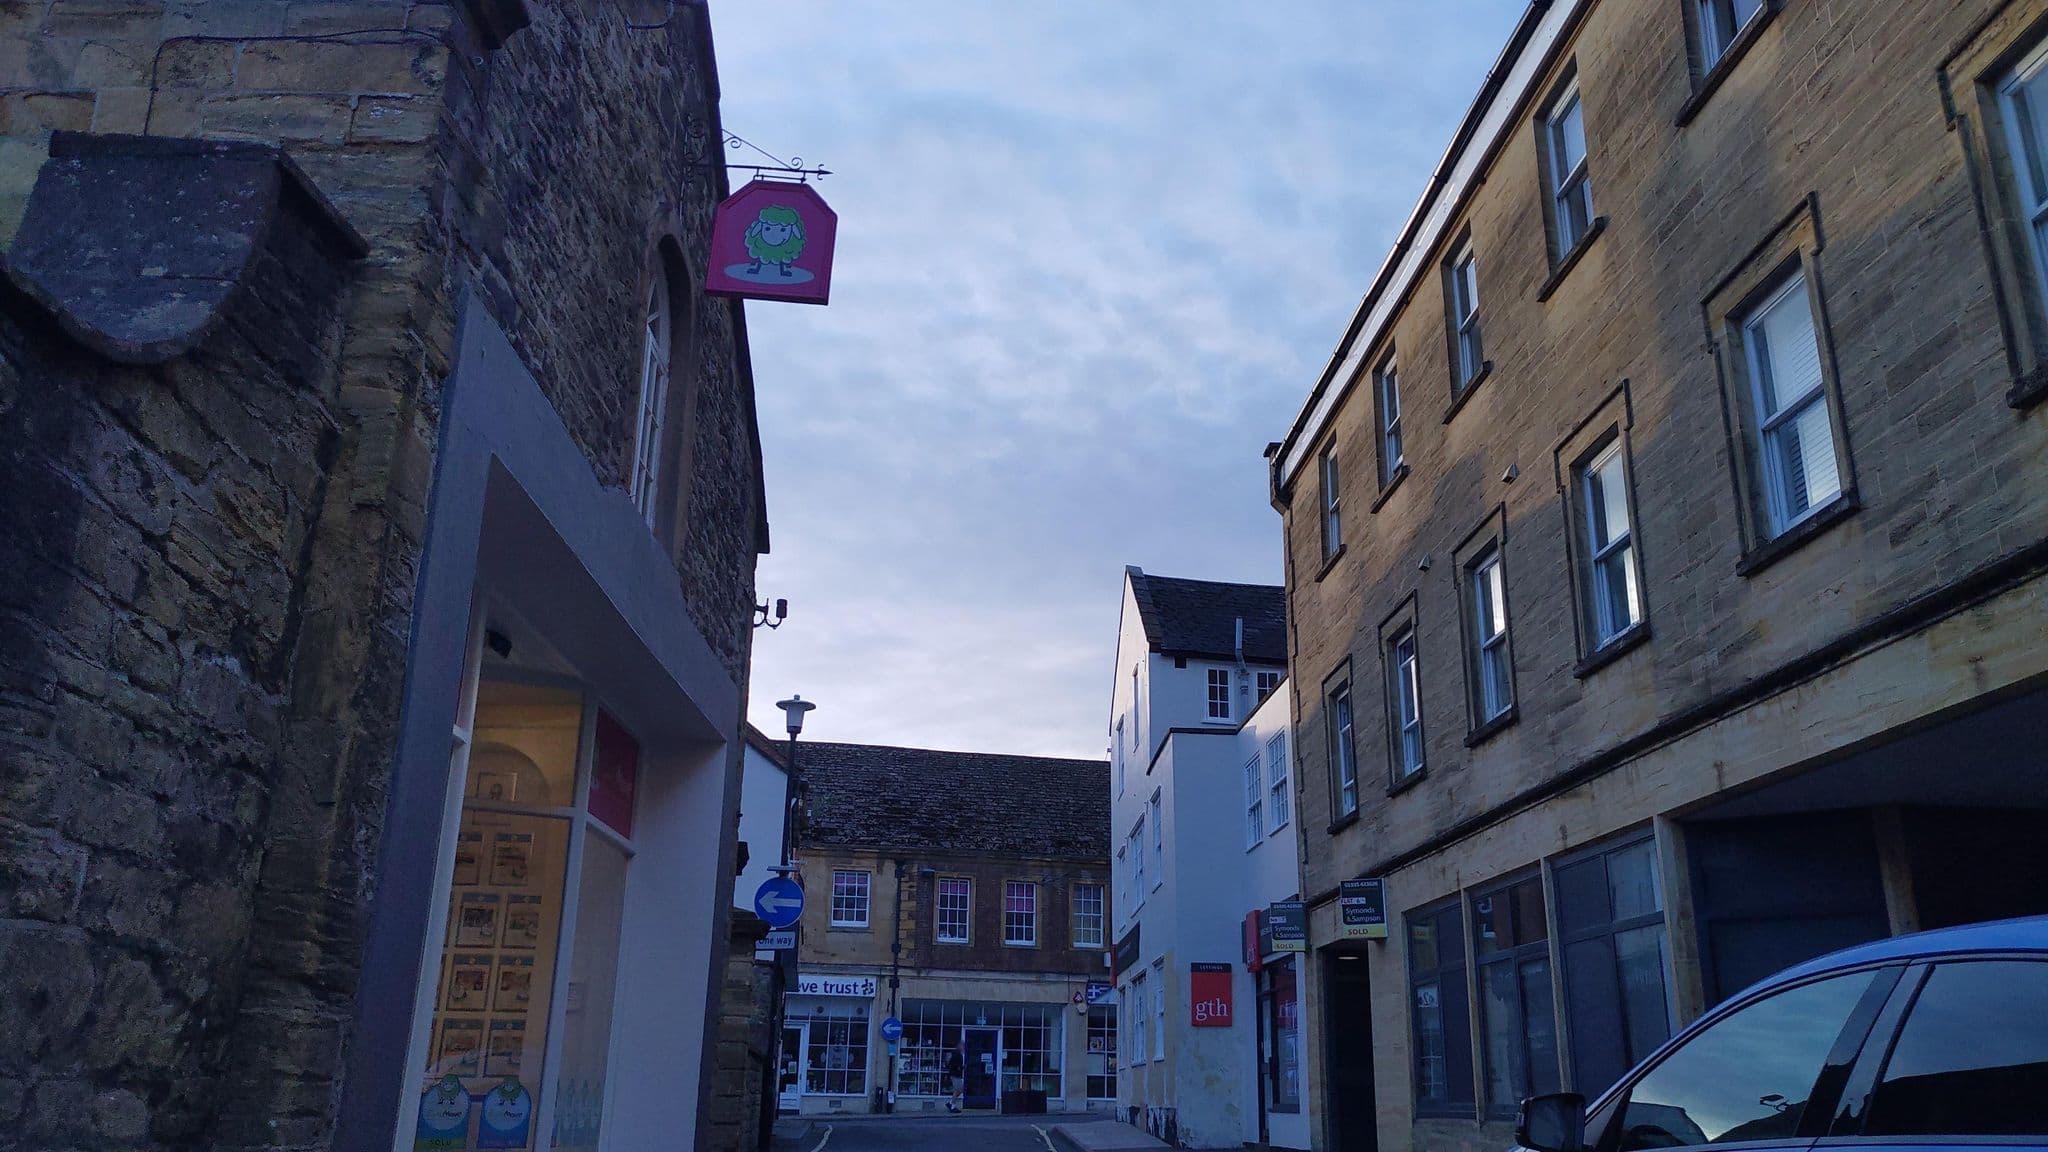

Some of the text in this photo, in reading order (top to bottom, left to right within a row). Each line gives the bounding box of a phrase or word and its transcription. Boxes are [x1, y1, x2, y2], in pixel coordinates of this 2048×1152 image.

[1345, 905, 1376, 915] Symonds
[1348, 928, 1369, 936] SOLD
[758, 936, 793, 946] One way
[823, 980, 859, 994] trust
[1195, 997, 1228, 1021] gth
